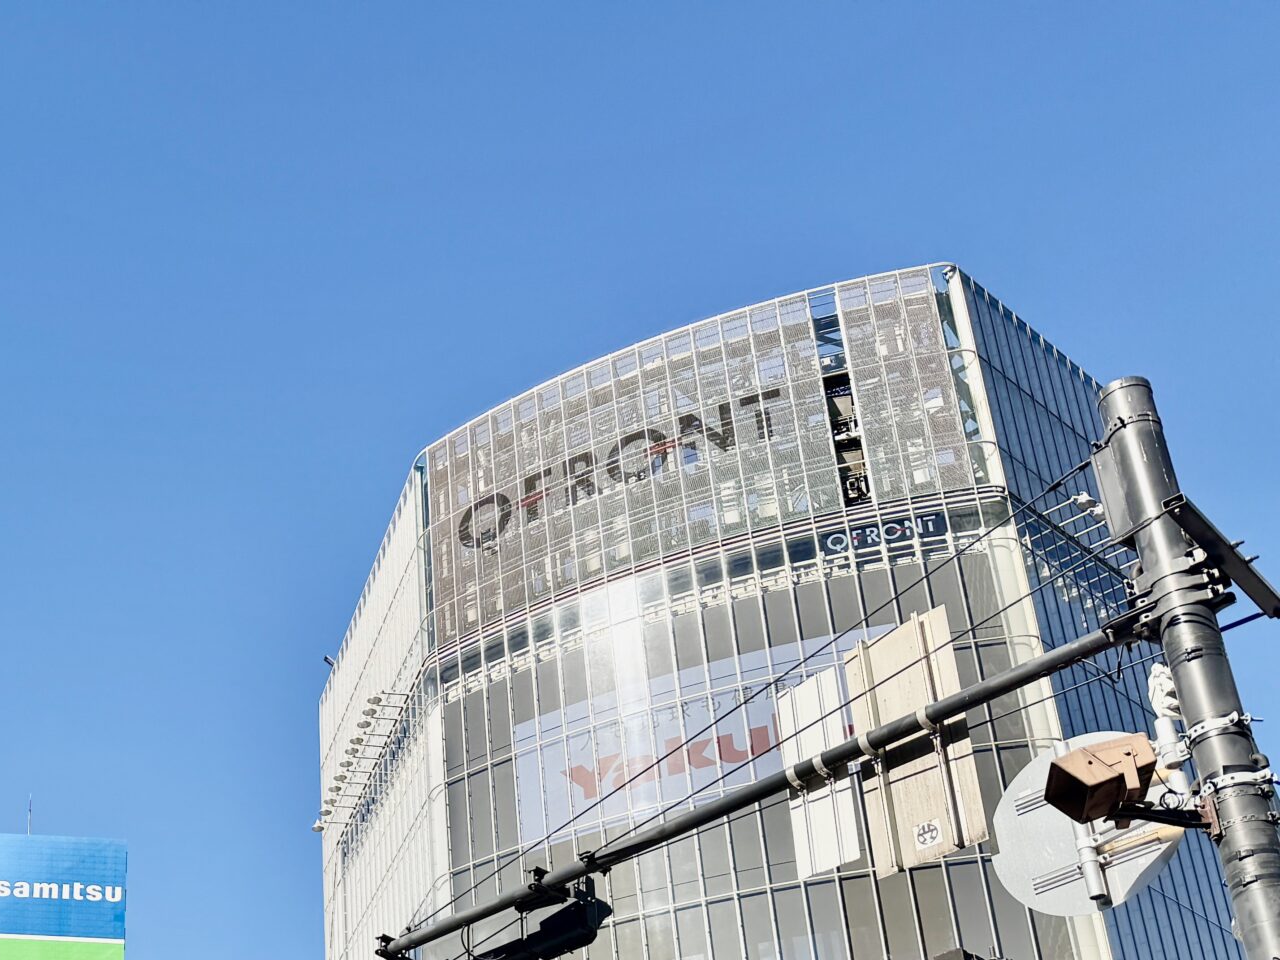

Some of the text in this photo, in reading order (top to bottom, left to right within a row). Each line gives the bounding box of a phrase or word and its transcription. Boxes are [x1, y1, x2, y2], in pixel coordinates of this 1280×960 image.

[459, 389, 781, 550] QFRONT
[826, 514, 936, 554] QFRONT
[560, 712, 783, 800] Yakul
